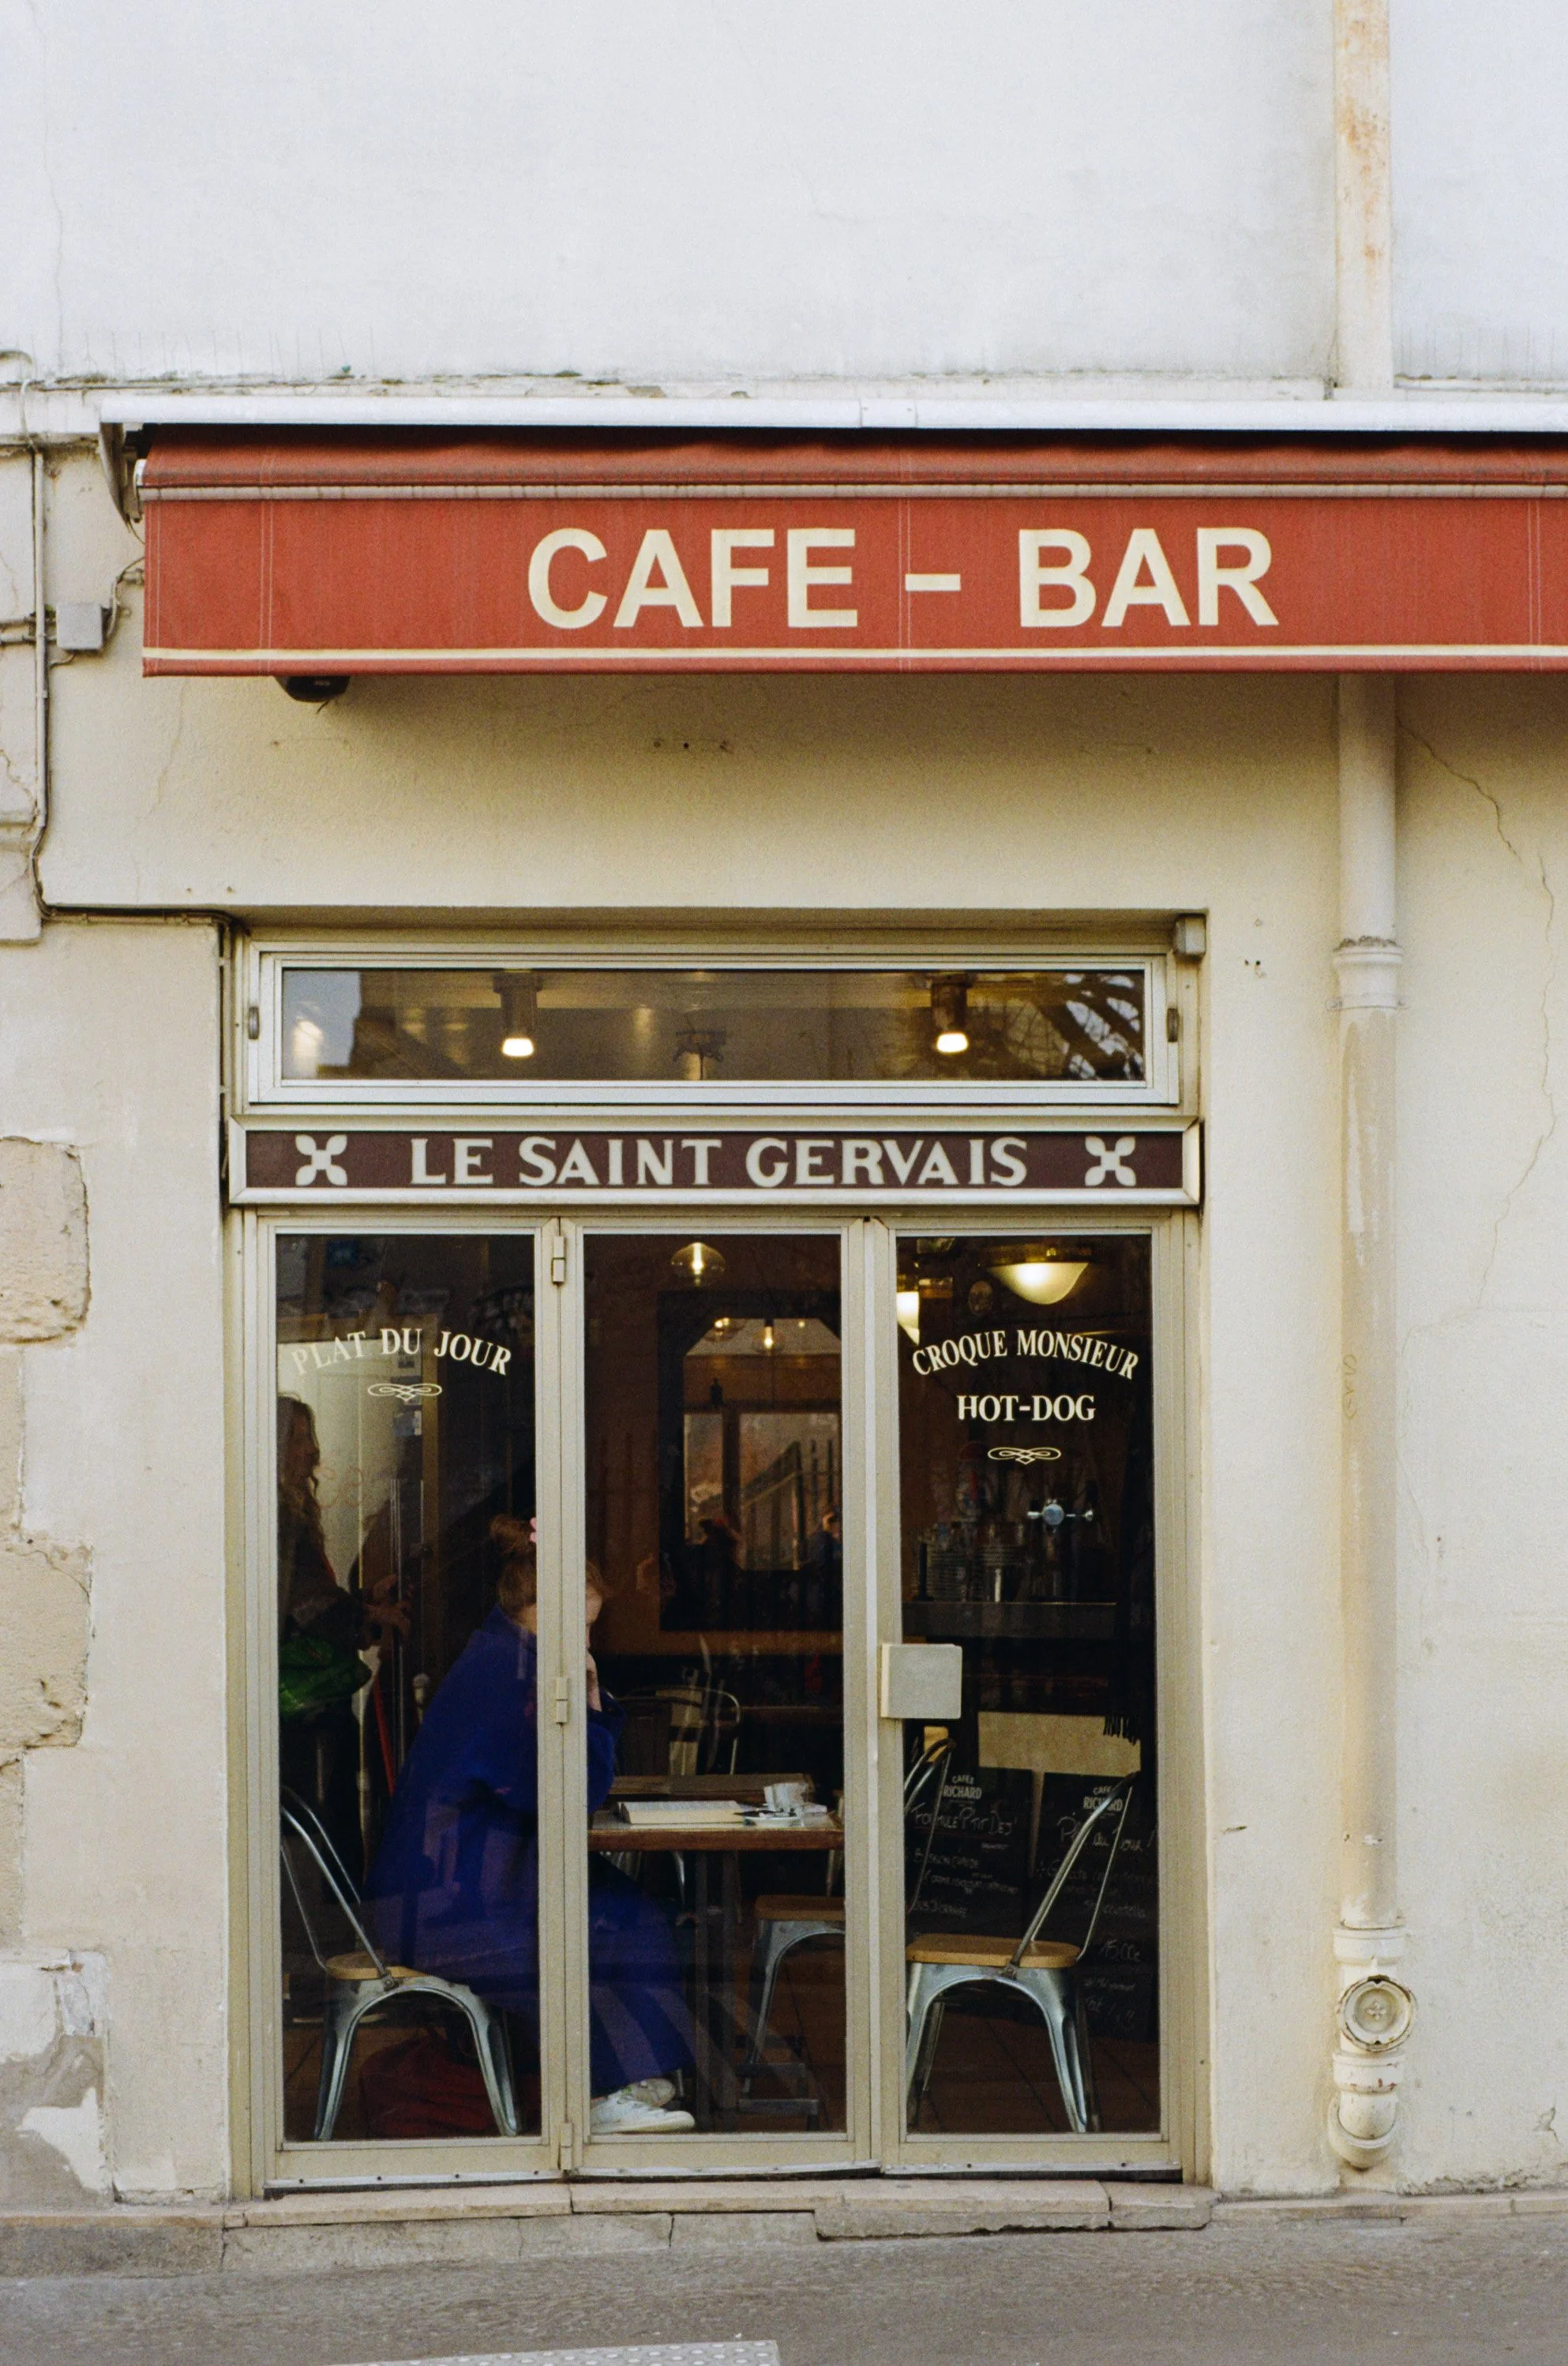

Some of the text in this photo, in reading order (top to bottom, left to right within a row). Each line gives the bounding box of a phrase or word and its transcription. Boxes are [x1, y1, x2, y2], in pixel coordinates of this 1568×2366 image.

[528, 528, 1279, 628] CAFE - BAR
[411, 1136, 1027, 1187] LE SAINT GERVAIS
[291, 1328, 512, 1376] PLAT DU JOUR
[912, 1329, 1139, 1380] CROQUE MONSIEUR
[957, 1395, 1096, 1421] HOT-DOG
[943, 1785, 983, 1800] RICHARD
